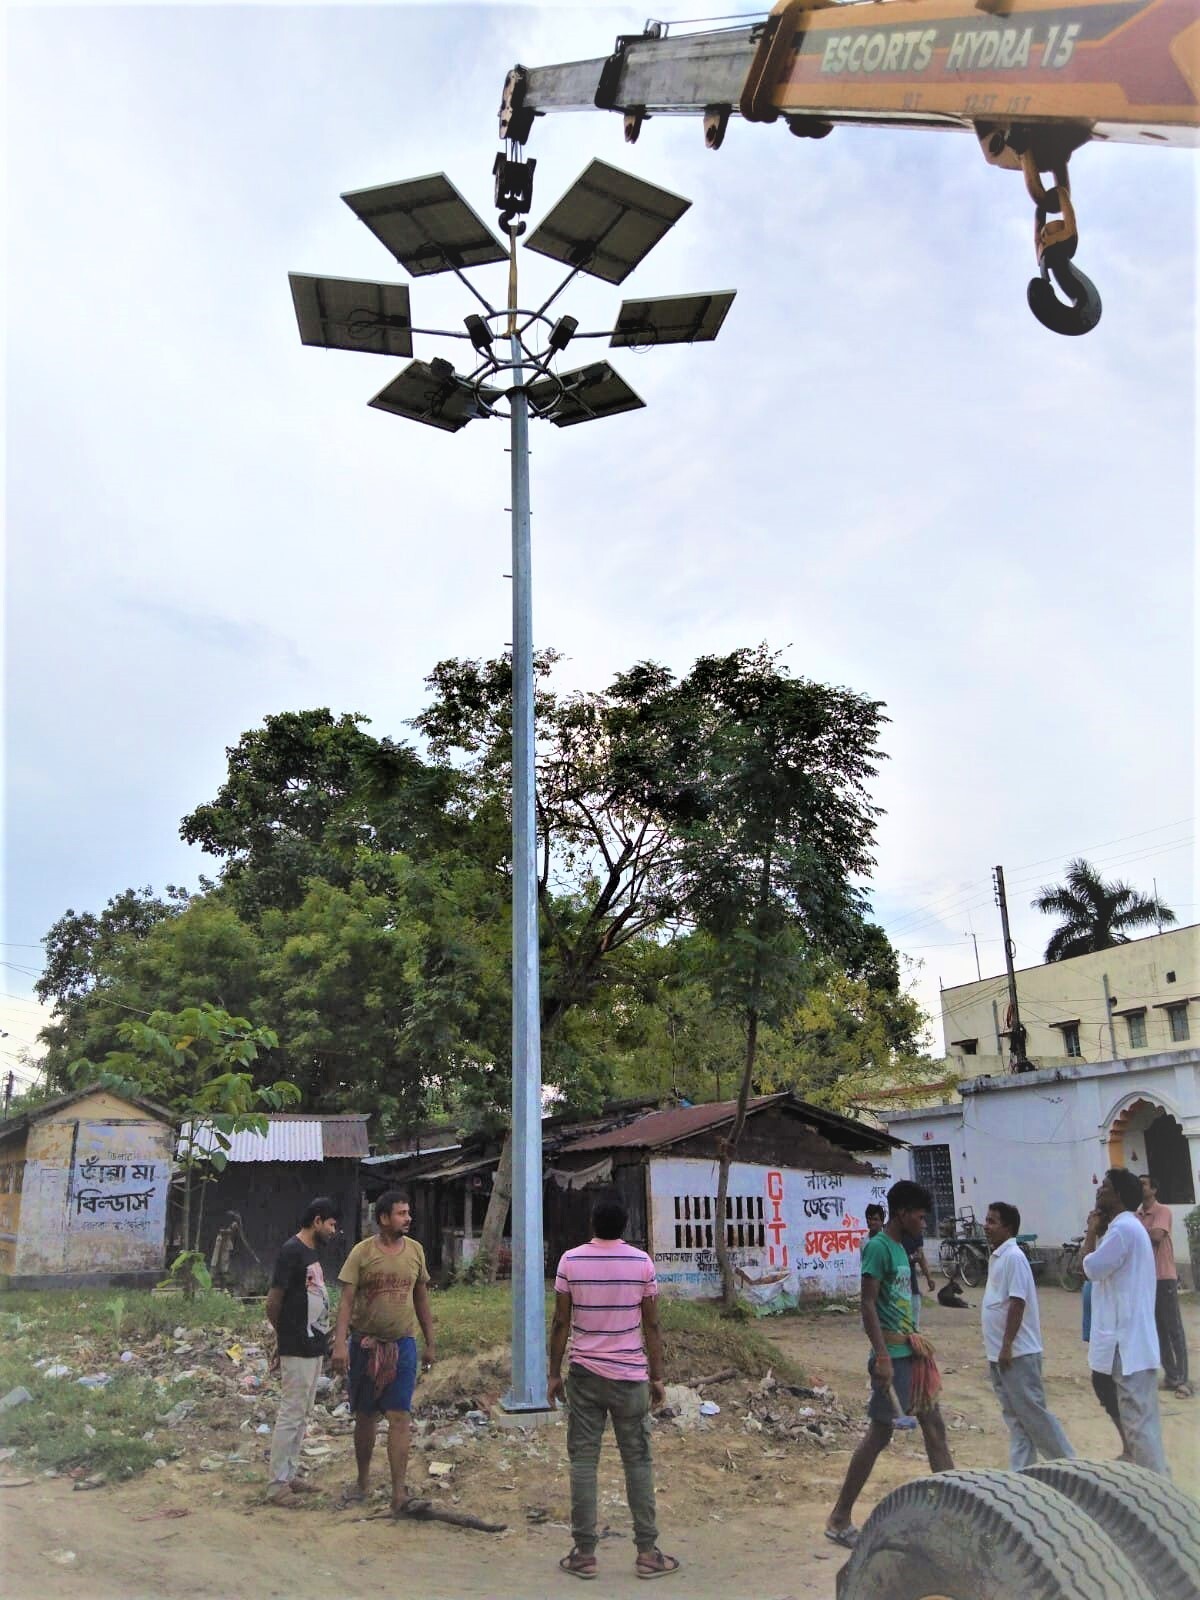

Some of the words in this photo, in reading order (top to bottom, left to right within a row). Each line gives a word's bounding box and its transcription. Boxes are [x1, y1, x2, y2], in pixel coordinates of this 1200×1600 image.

[821, 29, 937, 72] ESCORTS
[946, 26, 1033, 69] HYDRA
[1041, 23, 1081, 69] 15
[131, 1164, 156, 1183] মা
[803, 1196, 846, 1220] জেলা
